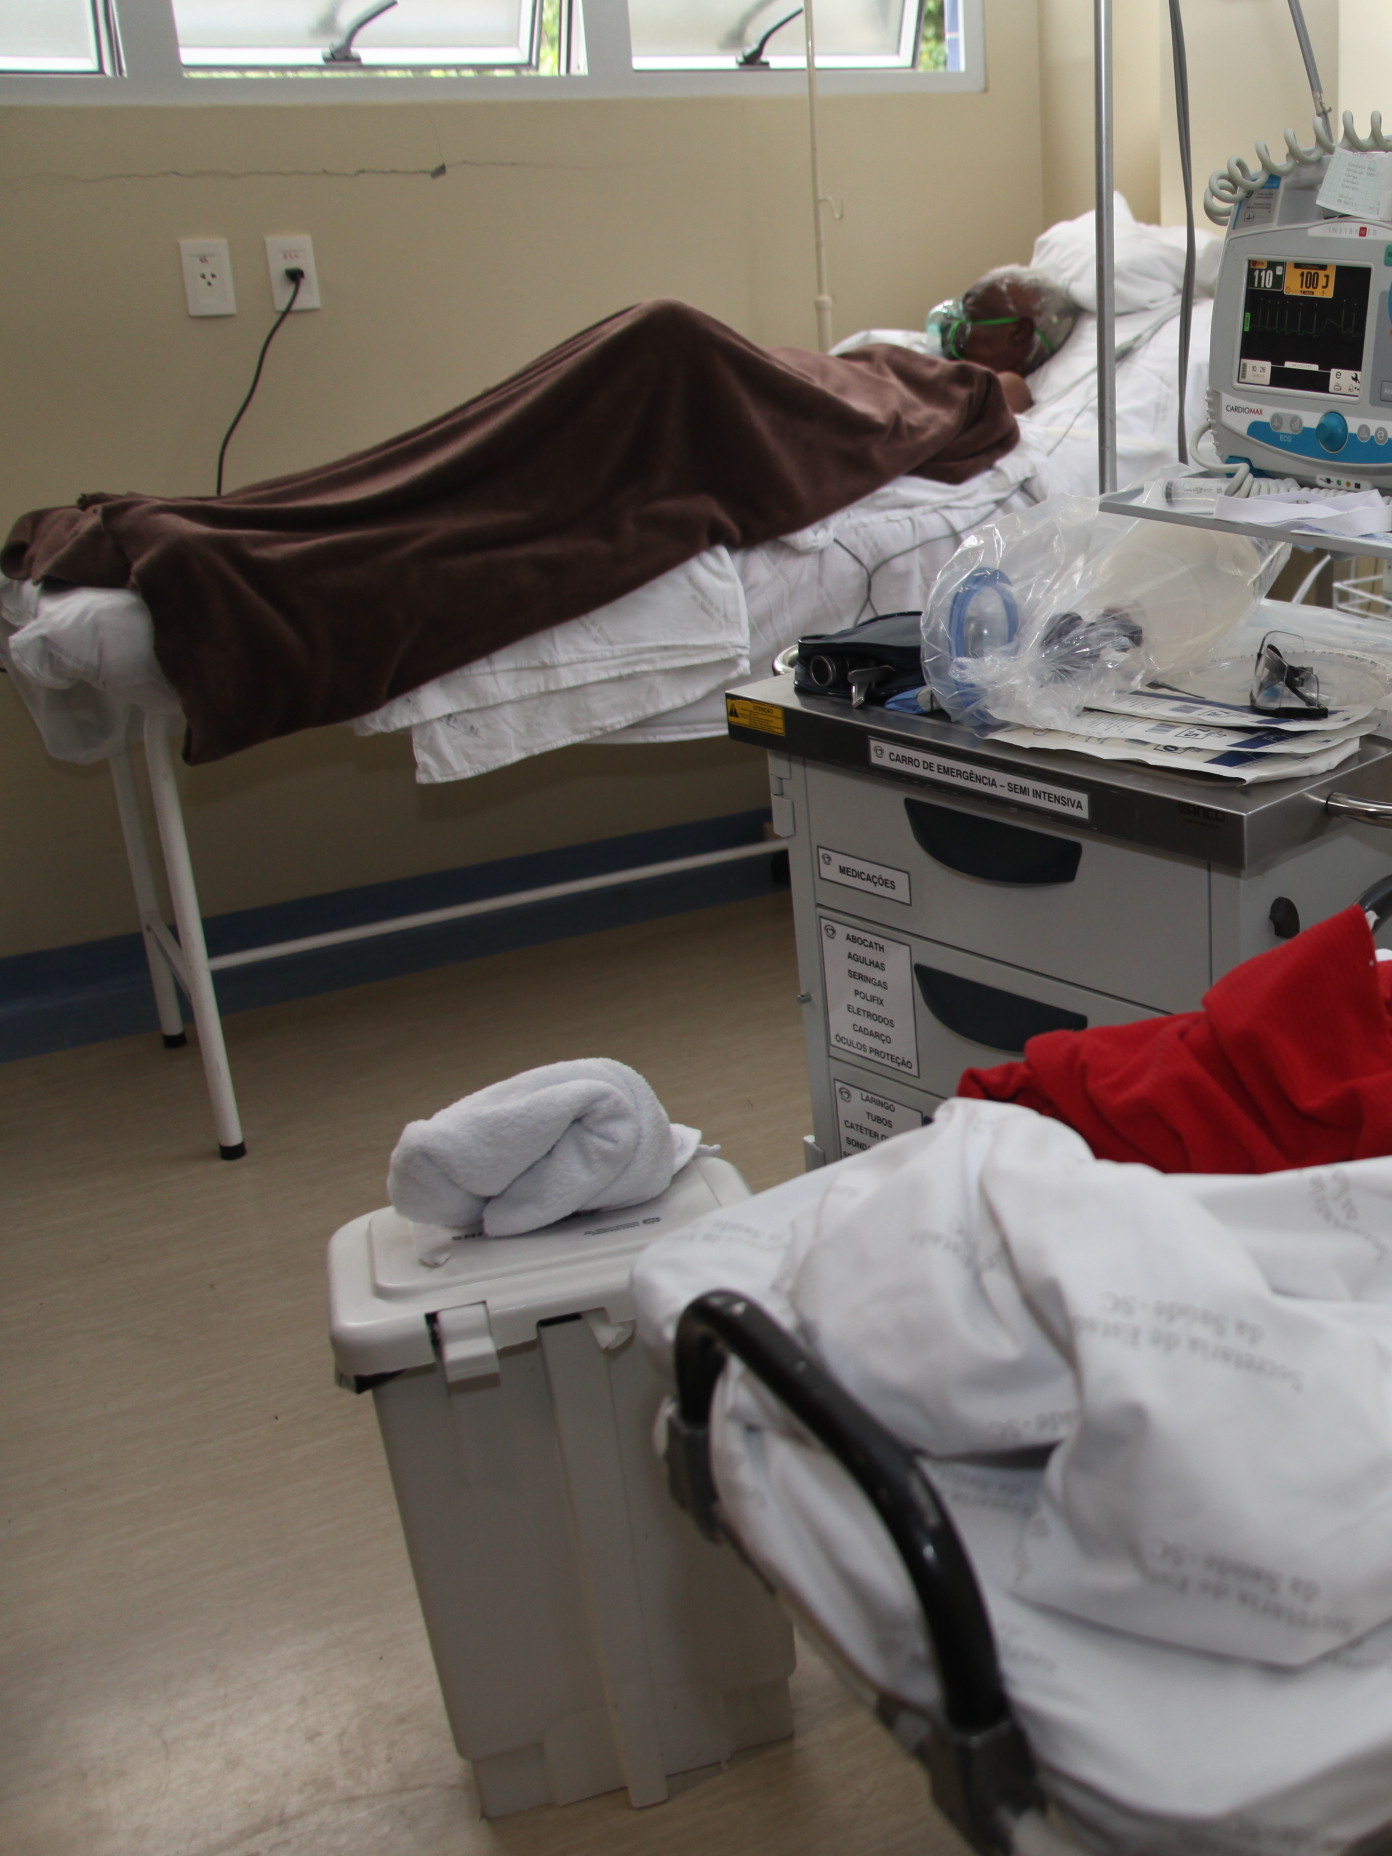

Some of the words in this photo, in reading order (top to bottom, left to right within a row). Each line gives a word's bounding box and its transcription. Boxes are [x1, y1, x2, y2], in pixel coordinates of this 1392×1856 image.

[1327, 226, 1378, 238] INSTRAMED
[1253, 269, 1273, 289] 110
[1299, 271, 1319, 290] 100
[1225, 404, 1264, 416] CARDIOMAX
[1279, 434, 1292, 442] ECG
[888, 751, 921, 768] CARRO
[922, 760, 935, 772] DE
[937, 764, 998, 789] EMERGÊNCIA
[1007, 782, 1030, 798] SEMI
[1032, 788, 1084, 811] INTENSIVA
[838, 863, 897, 891] MEDICAÇÕES
[845, 933, 885, 953] ABOCATH
[847, 952, 886, 972] AGULHAS
[847, 969, 888, 990] SERINGAS
[854, 989, 885, 1007] POLIFIX
[847, 1004, 895, 1028] ELETRODOS
[852, 1023, 892, 1045] CADARÇO
[835, 1033, 868, 1053] ÓCULOS
[869, 1046, 913, 1070] PROTEÇÃO
[860, 1092, 896, 1112] LARINGO
[844, 1119, 879, 1140] CATÉTER
[866, 1111, 893, 1128] TUBOS
[1149, 1330, 1181, 1355] de
[1234, 1319, 1265, 1347] da
[1200, 1578, 1230, 1602] de
[1290, 1577, 1321, 1604] da
